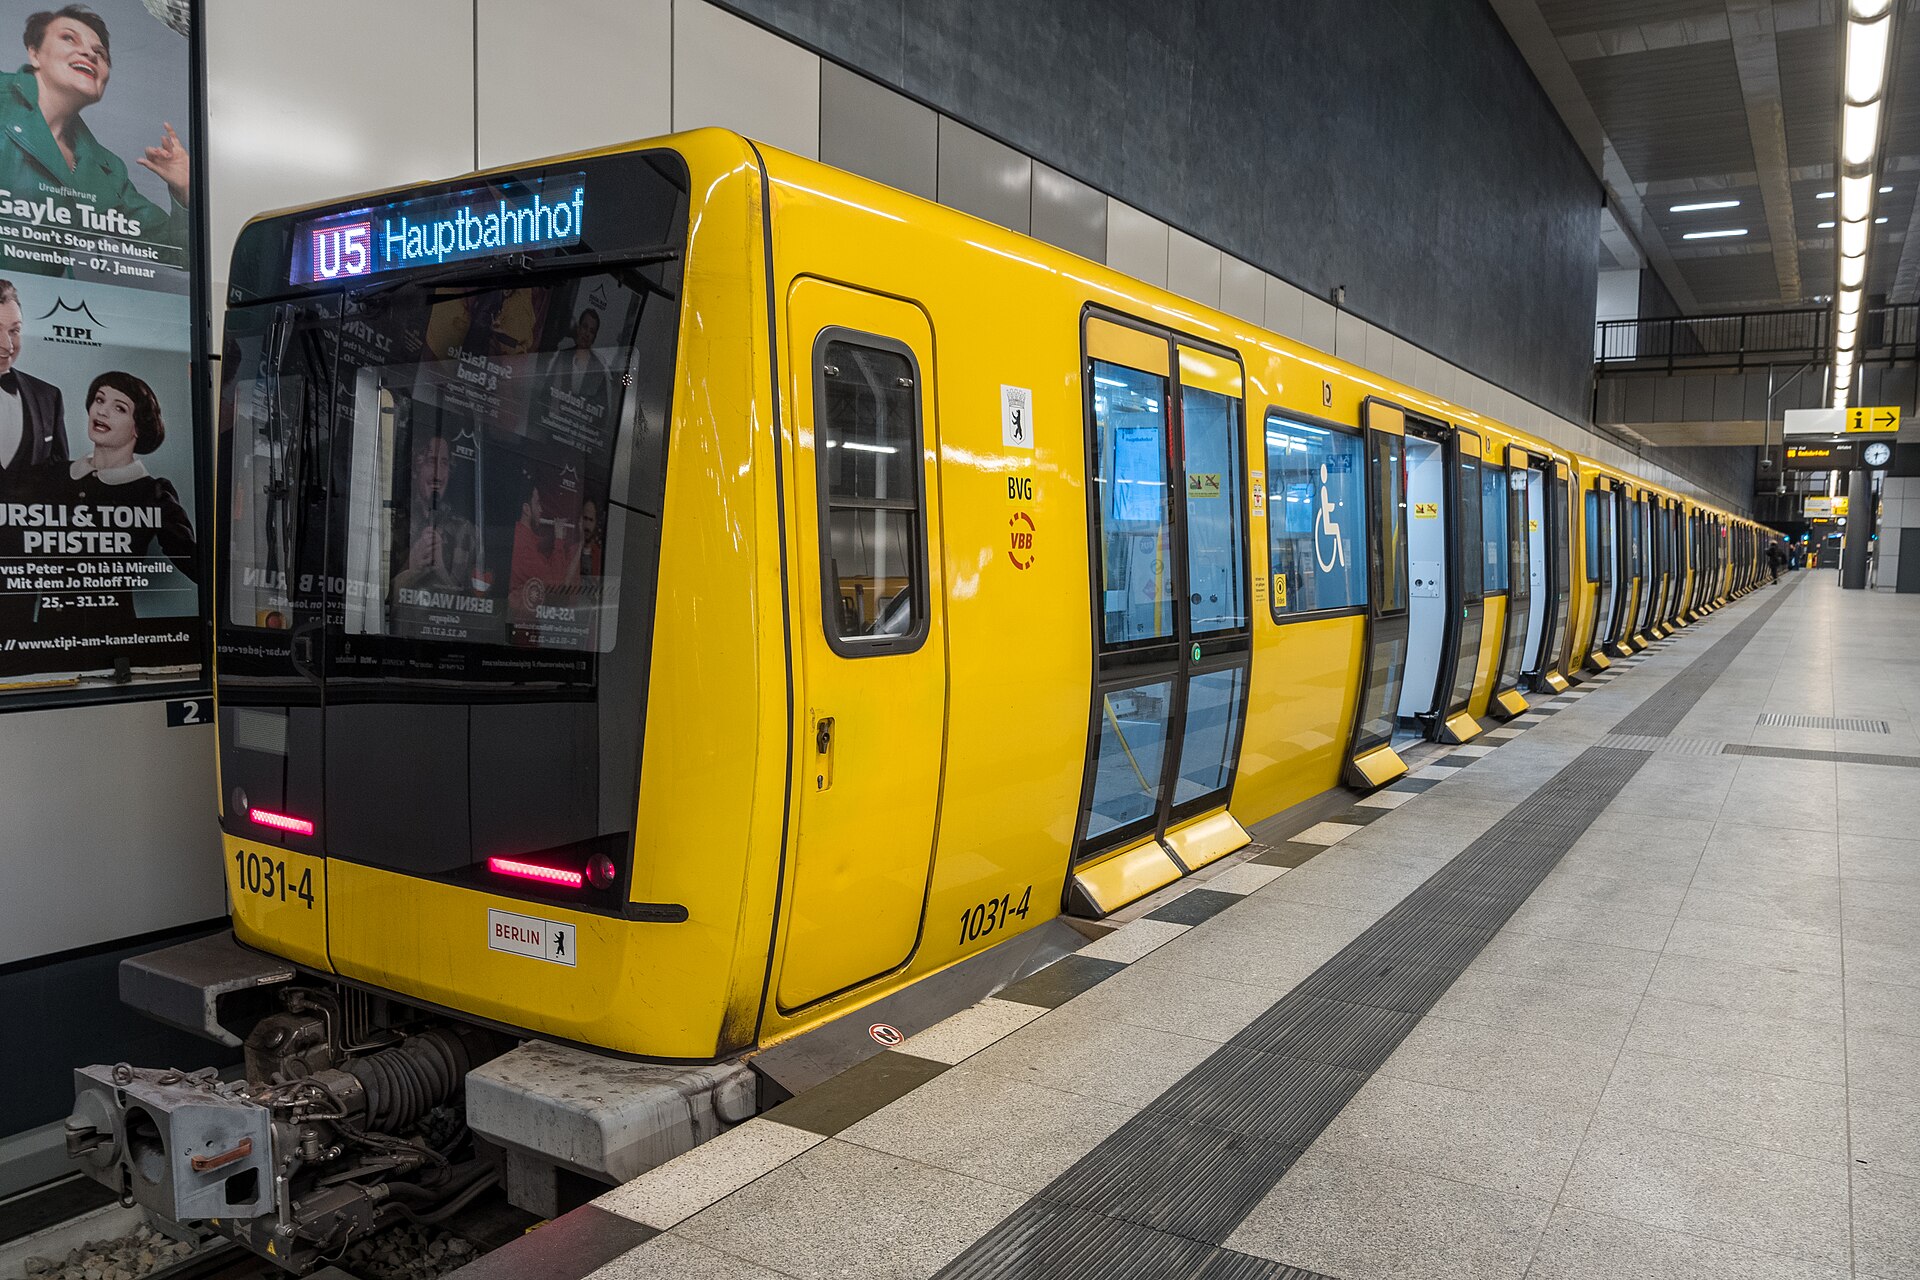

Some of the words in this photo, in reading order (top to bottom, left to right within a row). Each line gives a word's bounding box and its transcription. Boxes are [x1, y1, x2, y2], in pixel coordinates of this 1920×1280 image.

[39, 182, 97, 202] Uraufführung
[0, 189, 72, 225] Gayle
[76, 203, 141, 236] Tufts
[318, 227, 368, 279] U5
[385, 187, 584, 263] Hauptbahnhof
[64, 233, 96, 251] Stop
[98, 238, 119, 253] the
[121, 242, 159, 260] Music
[3, 243, 76, 266] November
[90, 257, 111, 272] 07.
[113, 261, 156, 278] Januar
[52, 324, 92, 340] TIPI
[1007, 476, 1033, 500] BVG
[72, 505, 97, 528] &
[97, 505, 163, 529] TONI
[23, 531, 133, 554] PFISTER
[1010, 532, 1033, 549] VBB
[26, 562, 64, 575] Peter
[77, 562, 96, 574] Oh
[99, 561, 111, 574] là
[112, 561, 124, 574] là
[126, 561, 174, 574] Mireille
[6, 577, 32, 590] Mit
[34, 577, 65, 589] dem
[66, 577, 81, 588] Jo
[83, 576, 123, 588] Roloff
[124, 575, 149, 587] Trio
[41, 597, 65, 609] 25.
[18, 632, 190, 650] www.tipi-am-kanzleramt.de
[183, 701, 200, 724] 2
[235, 849, 315, 910] 1031-4
[958, 885, 1033, 946] 1031-4
[495, 922, 541, 946] BERLIN
